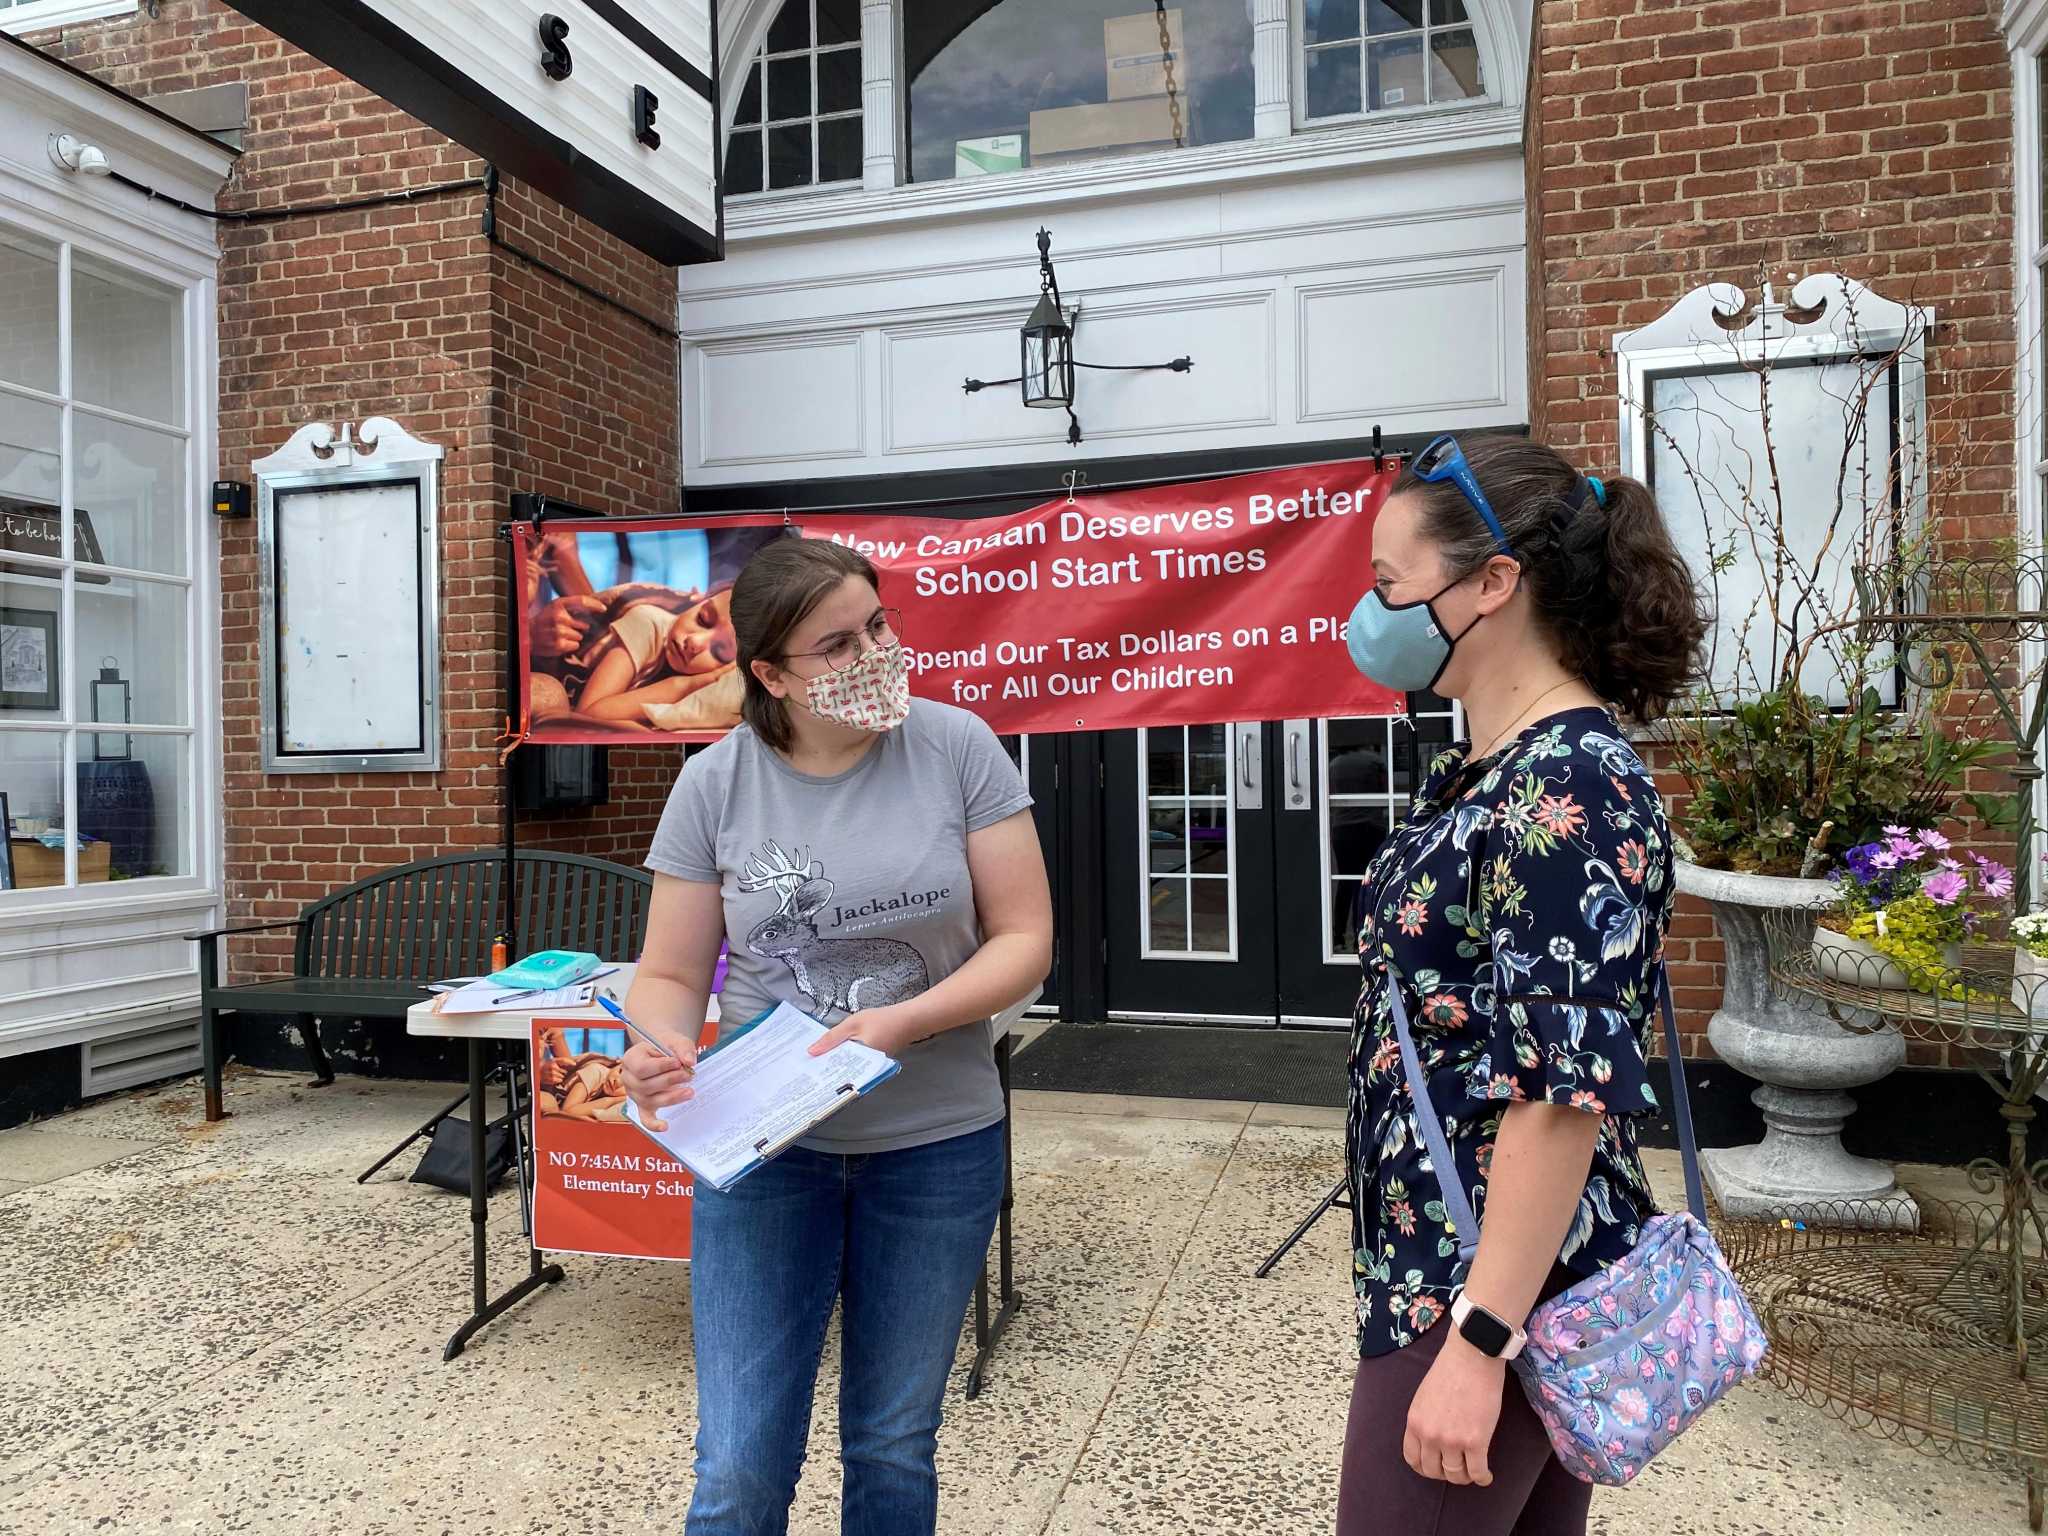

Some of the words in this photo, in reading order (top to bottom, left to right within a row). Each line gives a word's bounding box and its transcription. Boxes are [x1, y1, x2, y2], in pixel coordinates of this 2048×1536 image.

[538, 13, 573, 81] S
[633, 84, 661, 151] E
[831, 532, 906, 559] New
[917, 521, 1046, 557] Canaan
[1060, 504, 1234, 543] Deserves
[1249, 486, 1372, 525] Better
[915, 560, 1038, 597] School
[1051, 552, 1142, 589] Start
[1150, 547, 1267, 580] Times
[901, 643, 987, 676] Spend
[995, 641, 1049, 666] Our
[1056, 637, 1111, 662] Tax
[1119, 629, 1223, 657] Dollars
[1232, 627, 1269, 648] on
[1279, 624, 1298, 645] a
[952, 679, 993, 702] for
[1002, 675, 1038, 700] All
[1047, 673, 1102, 697] Our
[1111, 664, 1234, 692] Children
[830, 887, 951, 928] Jackalope
[548, 1151, 577, 1168] NO
[580, 1153, 641, 1172] 7:45AM
[562, 1174, 651, 1200] Elementary
